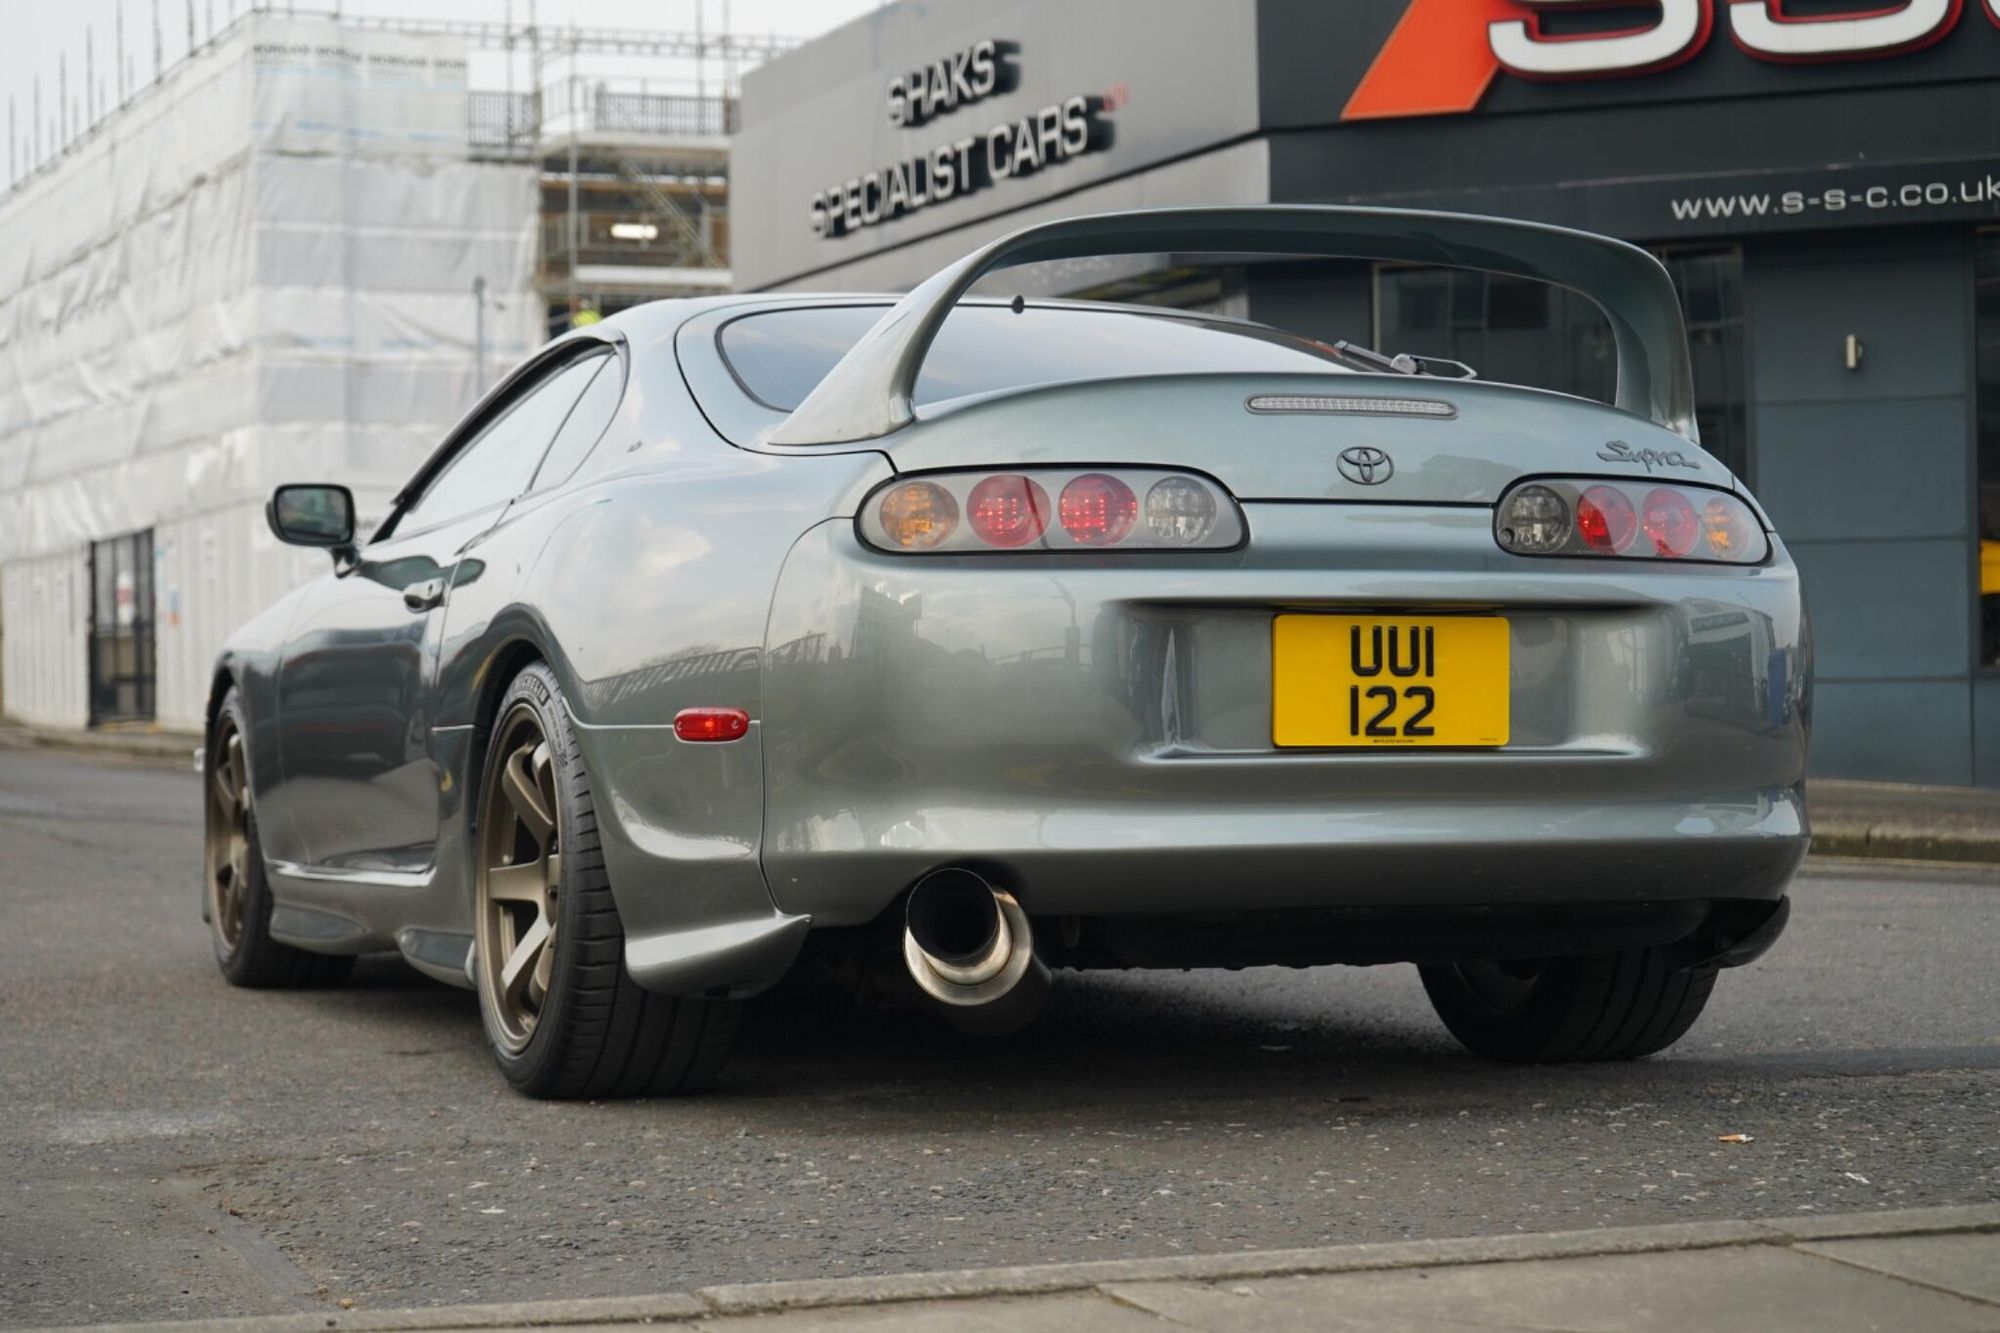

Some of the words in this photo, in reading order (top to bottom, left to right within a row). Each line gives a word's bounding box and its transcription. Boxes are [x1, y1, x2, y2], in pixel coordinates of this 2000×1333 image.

[887, 40, 997, 127] SHAKS
[808, 138, 975, 238] SPECIALIST
[987, 96, 1090, 180] CARS
[1671, 174, 2000, 220] www.s-s-c.co.uk
[1596, 440, 1700, 474] Supra
[1350, 625, 1435, 677] UUI
[1350, 685, 1435, 736] 122
